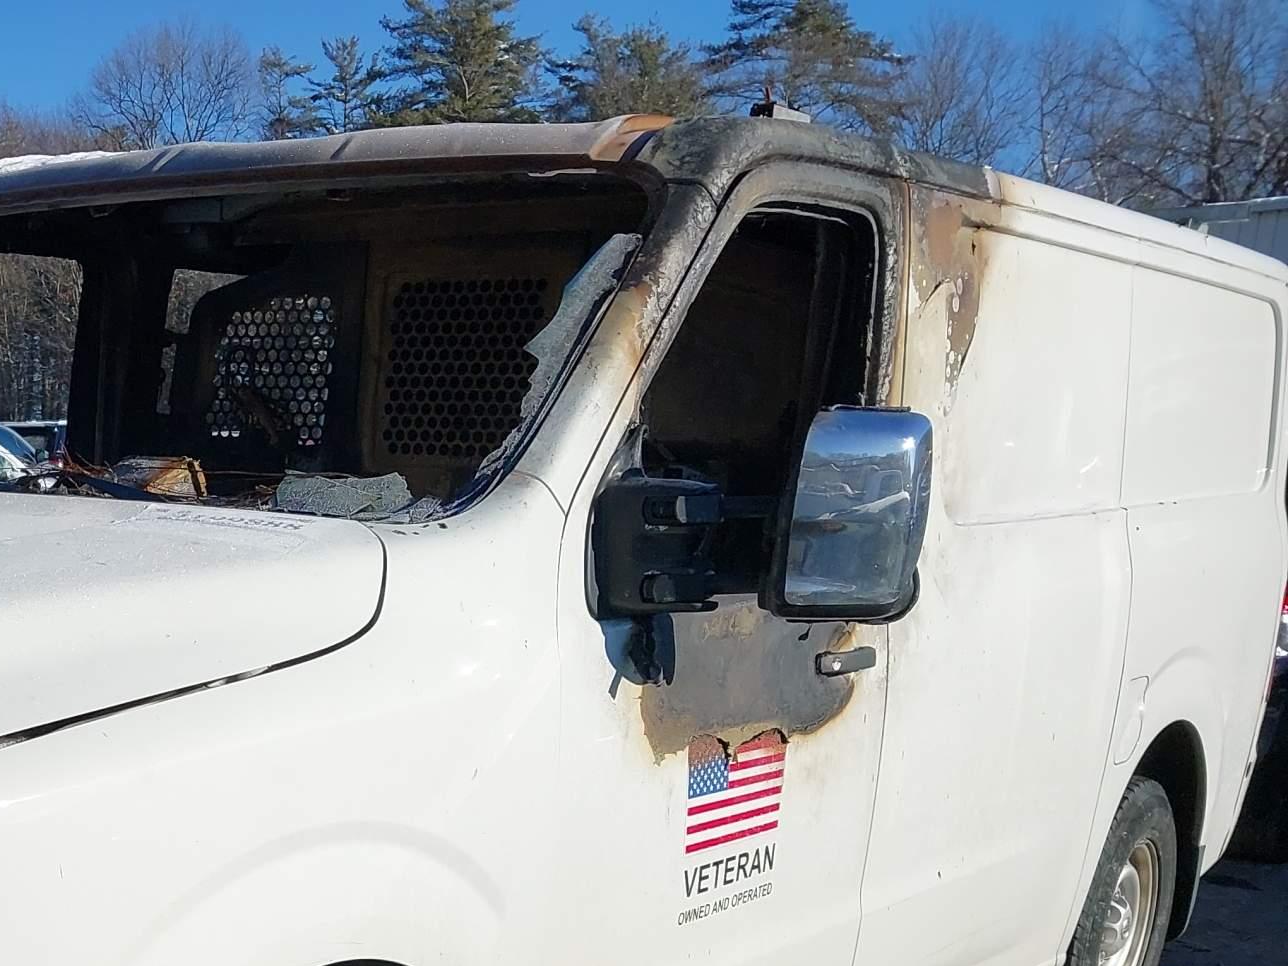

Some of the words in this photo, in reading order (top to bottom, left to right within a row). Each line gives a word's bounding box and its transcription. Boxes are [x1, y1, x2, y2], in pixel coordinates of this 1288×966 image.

[684, 843, 775, 897] VETERAN
[678, 904, 711, 927] OWNED
[711, 897, 730, 915] AND
[731, 883, 772, 907] OPERATED
